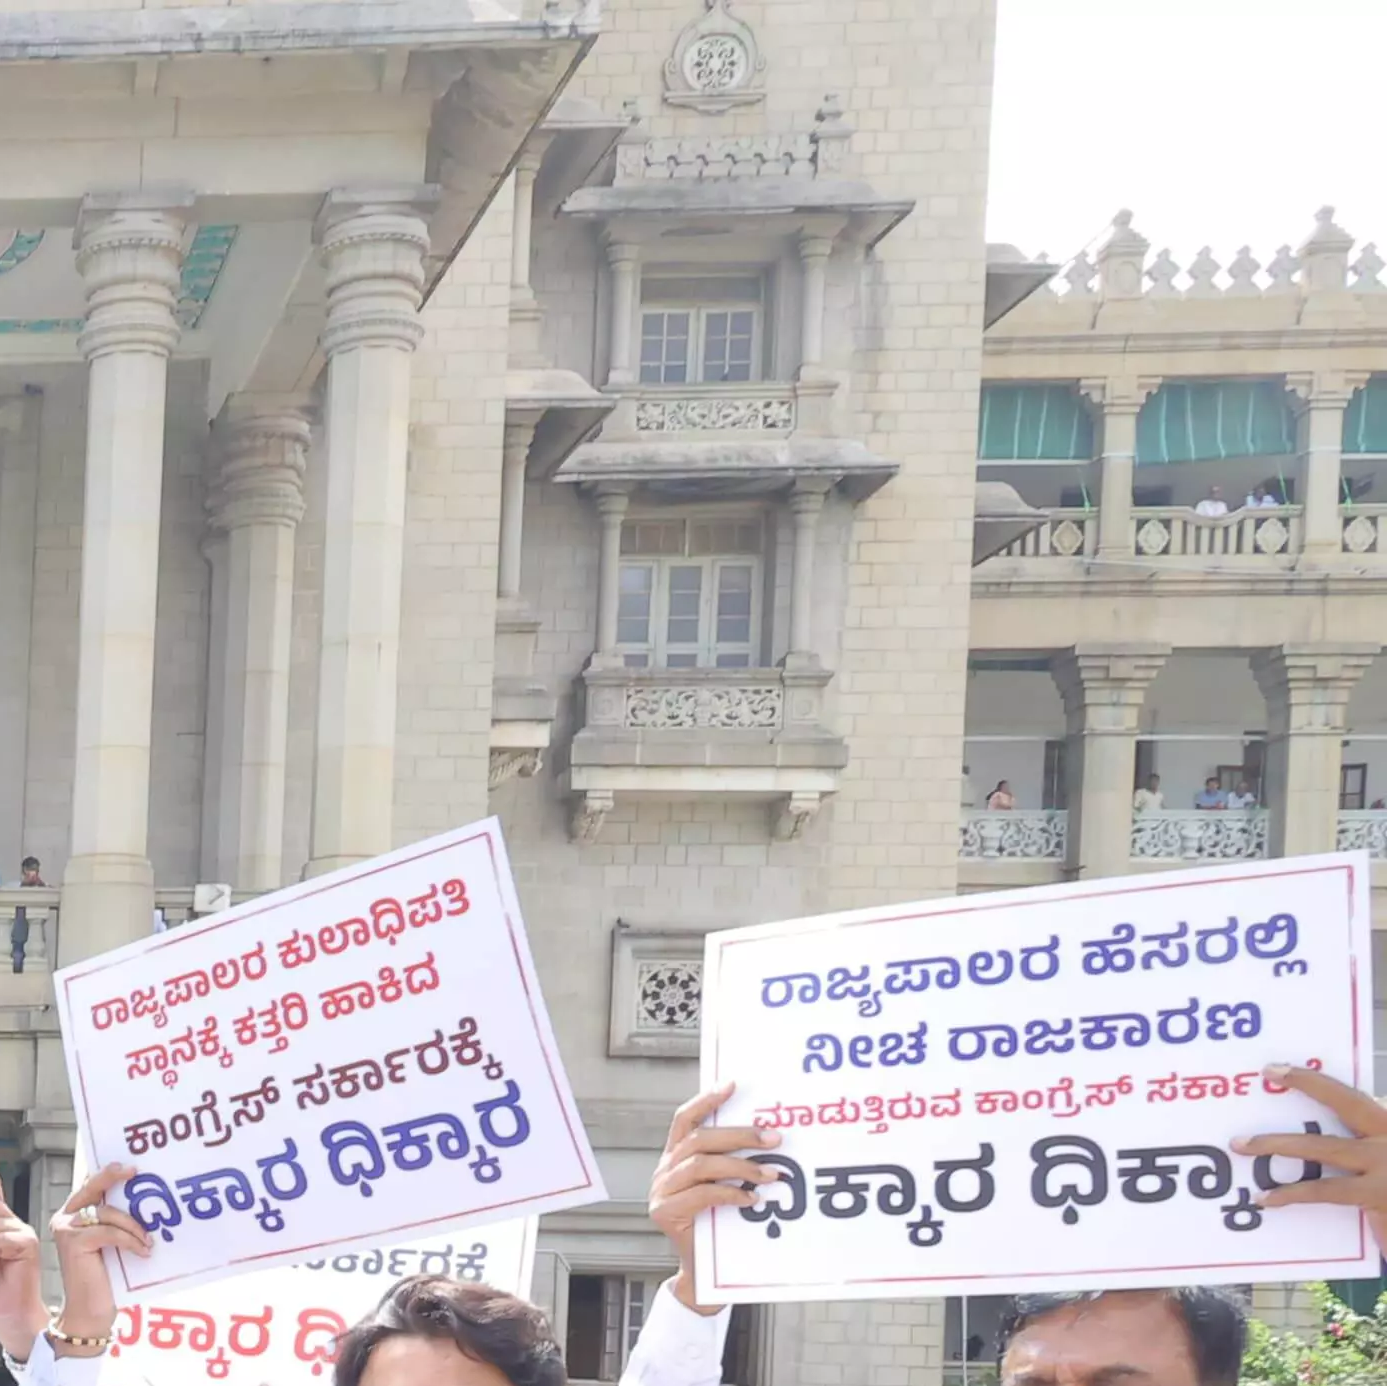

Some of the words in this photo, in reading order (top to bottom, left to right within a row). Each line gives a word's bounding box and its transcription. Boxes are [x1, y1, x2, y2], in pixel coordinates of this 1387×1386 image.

[91, 942, 267, 1030] ರಾಜ್ಯಪಾಲರ
[277, 879, 470, 968] ಕುಲಾಧಿಪತಿ
[762, 935, 1059, 1017] ರಾಜ್ಯಪಾಲರ
[1082, 914, 1307, 977] ಹೆಸರಲ್ಲಿ
[126, 1016, 233, 1089] ಸ್ಥಾನಕ್ಕೆ
[233, 993, 308, 1054] ಕತ್ತರಿ
[319, 952, 439, 1020] ಹಾಕಿದ
[803, 1022, 927, 1073] ನೀಚ
[949, 998, 1261, 1061] ರಾಜಕಾರಣ
[125, 1076, 280, 1156] ಕಾಂಗ್ರೆಸ್
[294, 1017, 503, 1111] ಸರ್ಕಾರಕ್ಕೆ
[753, 1088, 960, 1134] ಮಾಡುತ್ತಿರುವ
[975, 1075, 1133, 1117] ಕಾಂಗ್ರೆಸ್
[124, 1138, 307, 1243] ಧಿಕ್ಕಾರ
[320, 1073, 530, 1197] ಧಿಕ್ಕಾರ
[739, 1143, 995, 1247] ಧಿಕ್ಕಾರ
